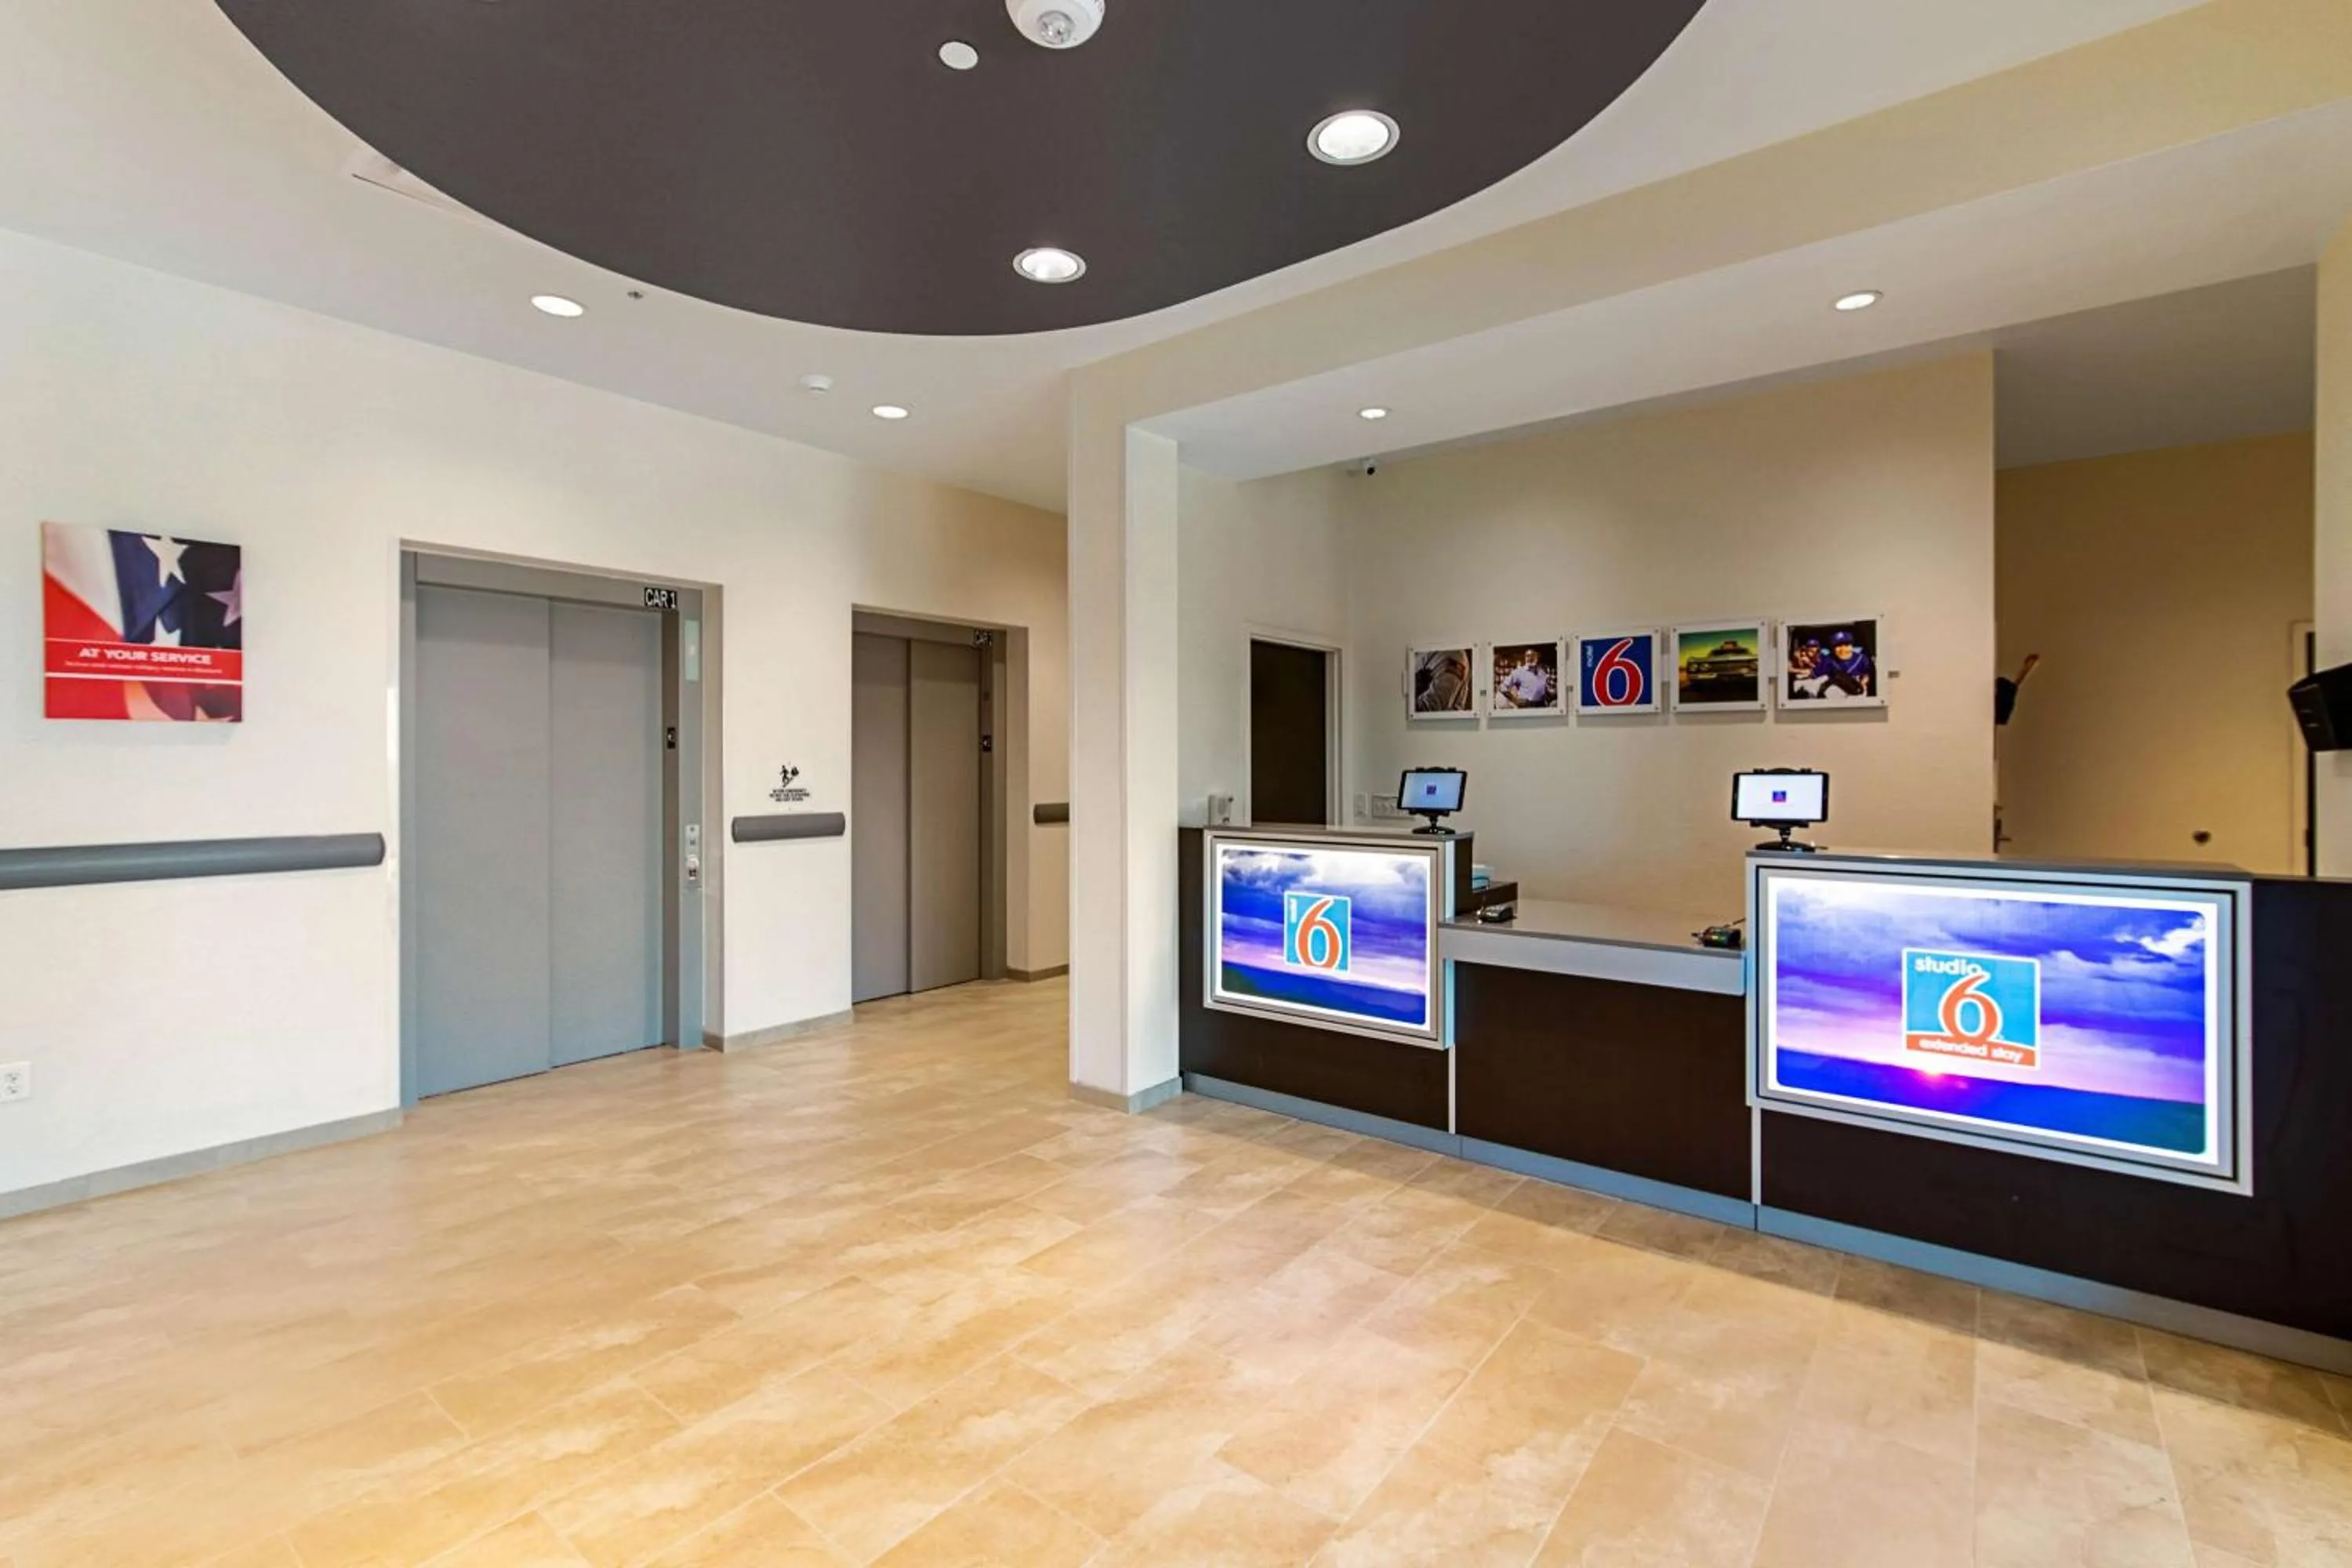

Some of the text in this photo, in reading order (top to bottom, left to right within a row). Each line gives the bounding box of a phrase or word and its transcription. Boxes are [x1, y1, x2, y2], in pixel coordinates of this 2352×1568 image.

[645, 589, 676, 609] CAR 1
[79, 648, 212, 665] AT YOUR SERVICE
[1592, 637, 1643, 707] 6
[1294, 896, 1343, 971] 6
[1915, 956, 1983, 976] studio
[1937, 971, 2003, 1043] 6
[1918, 1038, 2024, 1064] extended stay
